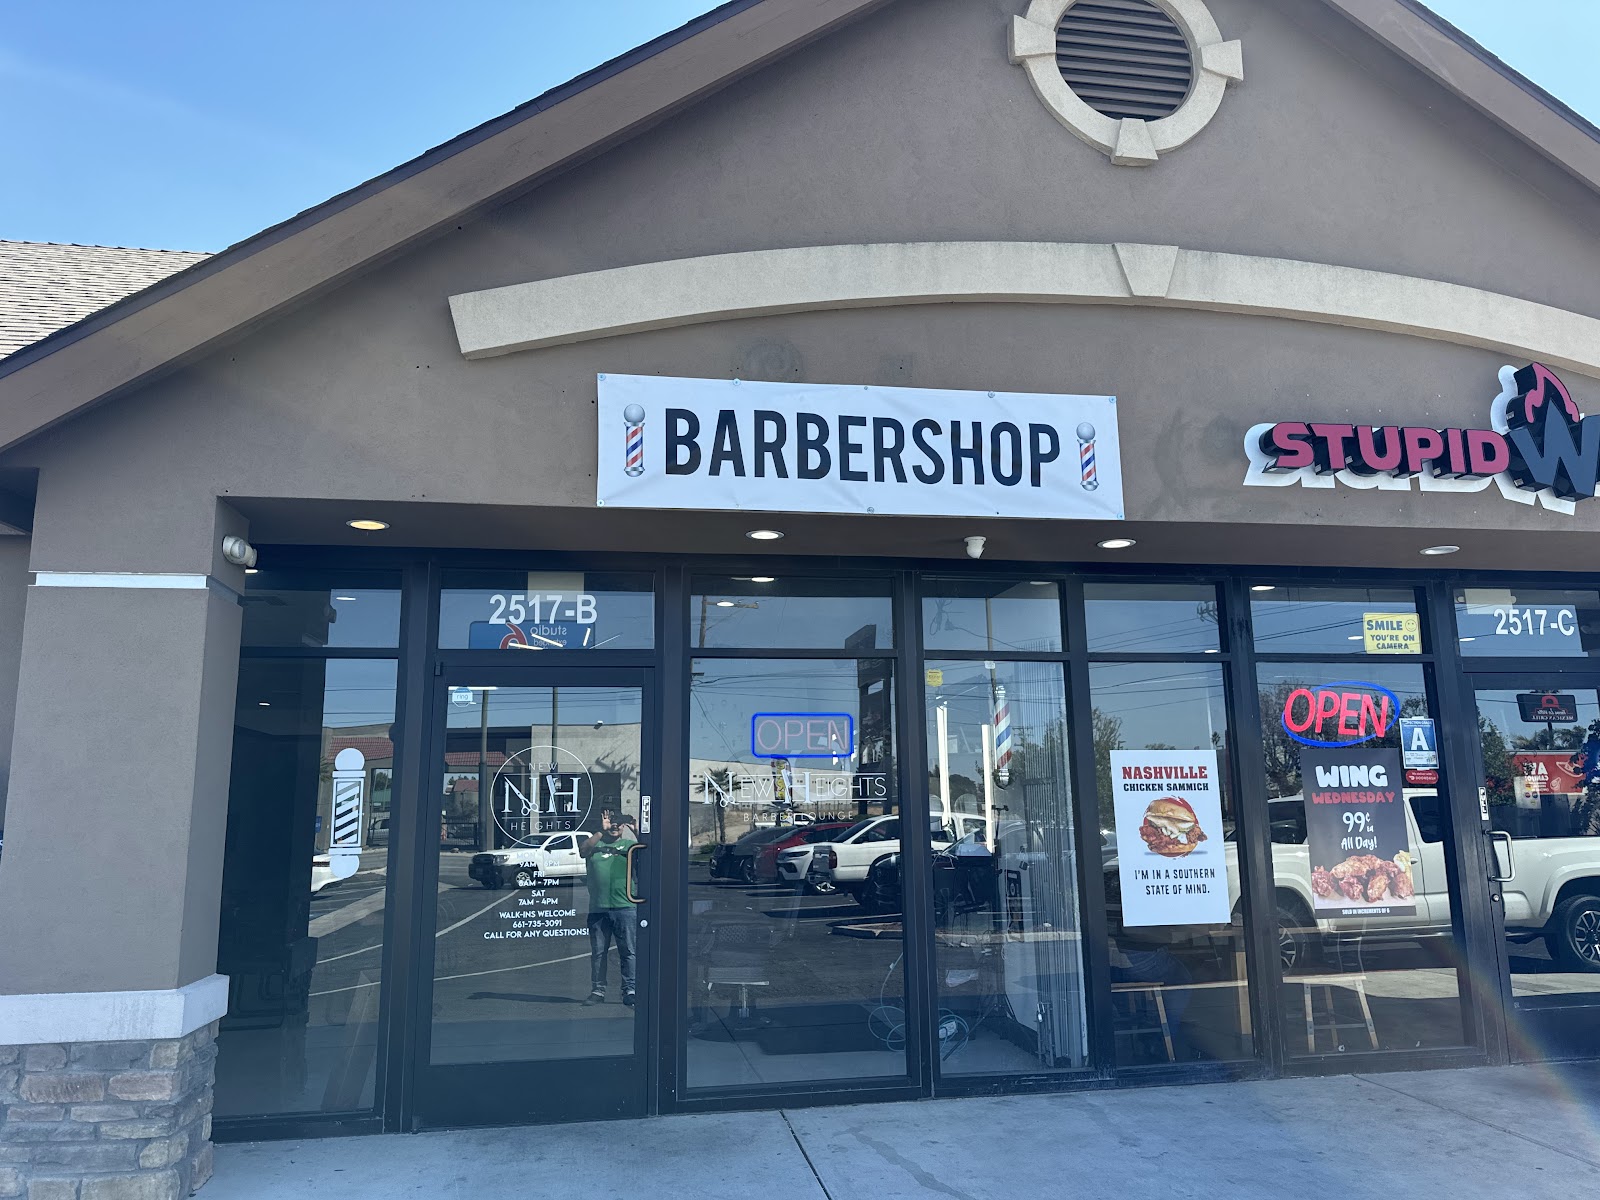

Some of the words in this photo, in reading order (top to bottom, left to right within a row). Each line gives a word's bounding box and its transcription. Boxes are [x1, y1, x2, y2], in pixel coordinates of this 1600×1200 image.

[664, 407, 1061, 488] BARBERSHOP
[1262, 420, 1510, 478] STUPID
[488, 594, 597, 624] 2517-B
[1366, 619, 1403, 631] SMILE
[1493, 608, 1575, 636] 2517-C
[1376, 642, 1409, 650] CAMERA
[1284, 688, 1389, 738] OPEN
[757, 719, 848, 750] OPEN
[1411, 728, 1429, 750] A
[528, 762, 558, 771] NEW
[1122, 766, 1208, 780] NASHVILLE
[1315, 765, 1389, 788] WING
[703, 768, 774, 807] NEW
[779, 769, 887, 805] HEIGHTS
[1123, 783, 1164, 792] CHICKEN
[1166, 782, 1209, 791] SAMMICH
[1311, 791, 1396, 805] WEDNESDAY
[801, 811, 854, 820] LOUNGE
[510, 821, 571, 831] HEGHTS
[1341, 836, 1354, 850] All
[1355, 836, 1378, 850] Day!
[533, 870, 545, 878] FRI
[1134, 869, 1149, 880] I'M
[1152, 869, 1161, 880] IN
[1164, 869, 1171, 880] A
[1173, 868, 1216, 880] SOUTHERN
[543, 878, 560, 886] 7PM
[531, 889, 546, 897] SAT
[1145, 884, 1170, 896] STATE
[1172, 884, 1182, 895] OF
[1185, 884, 1210, 895] MIND.
[518, 898, 534, 906] 7AM
[541, 897, 558, 905] 4PM
[499, 910, 536, 919] WALK-INS
[537, 908, 577, 918] WELCOME
[512, 919, 562, 928] 661-735-3091
[483, 931, 505, 939] CALL
[506, 930, 523, 938] FOR
[524, 930, 541, 938] ANY
[542, 928, 590, 937] QUESTIONS!
